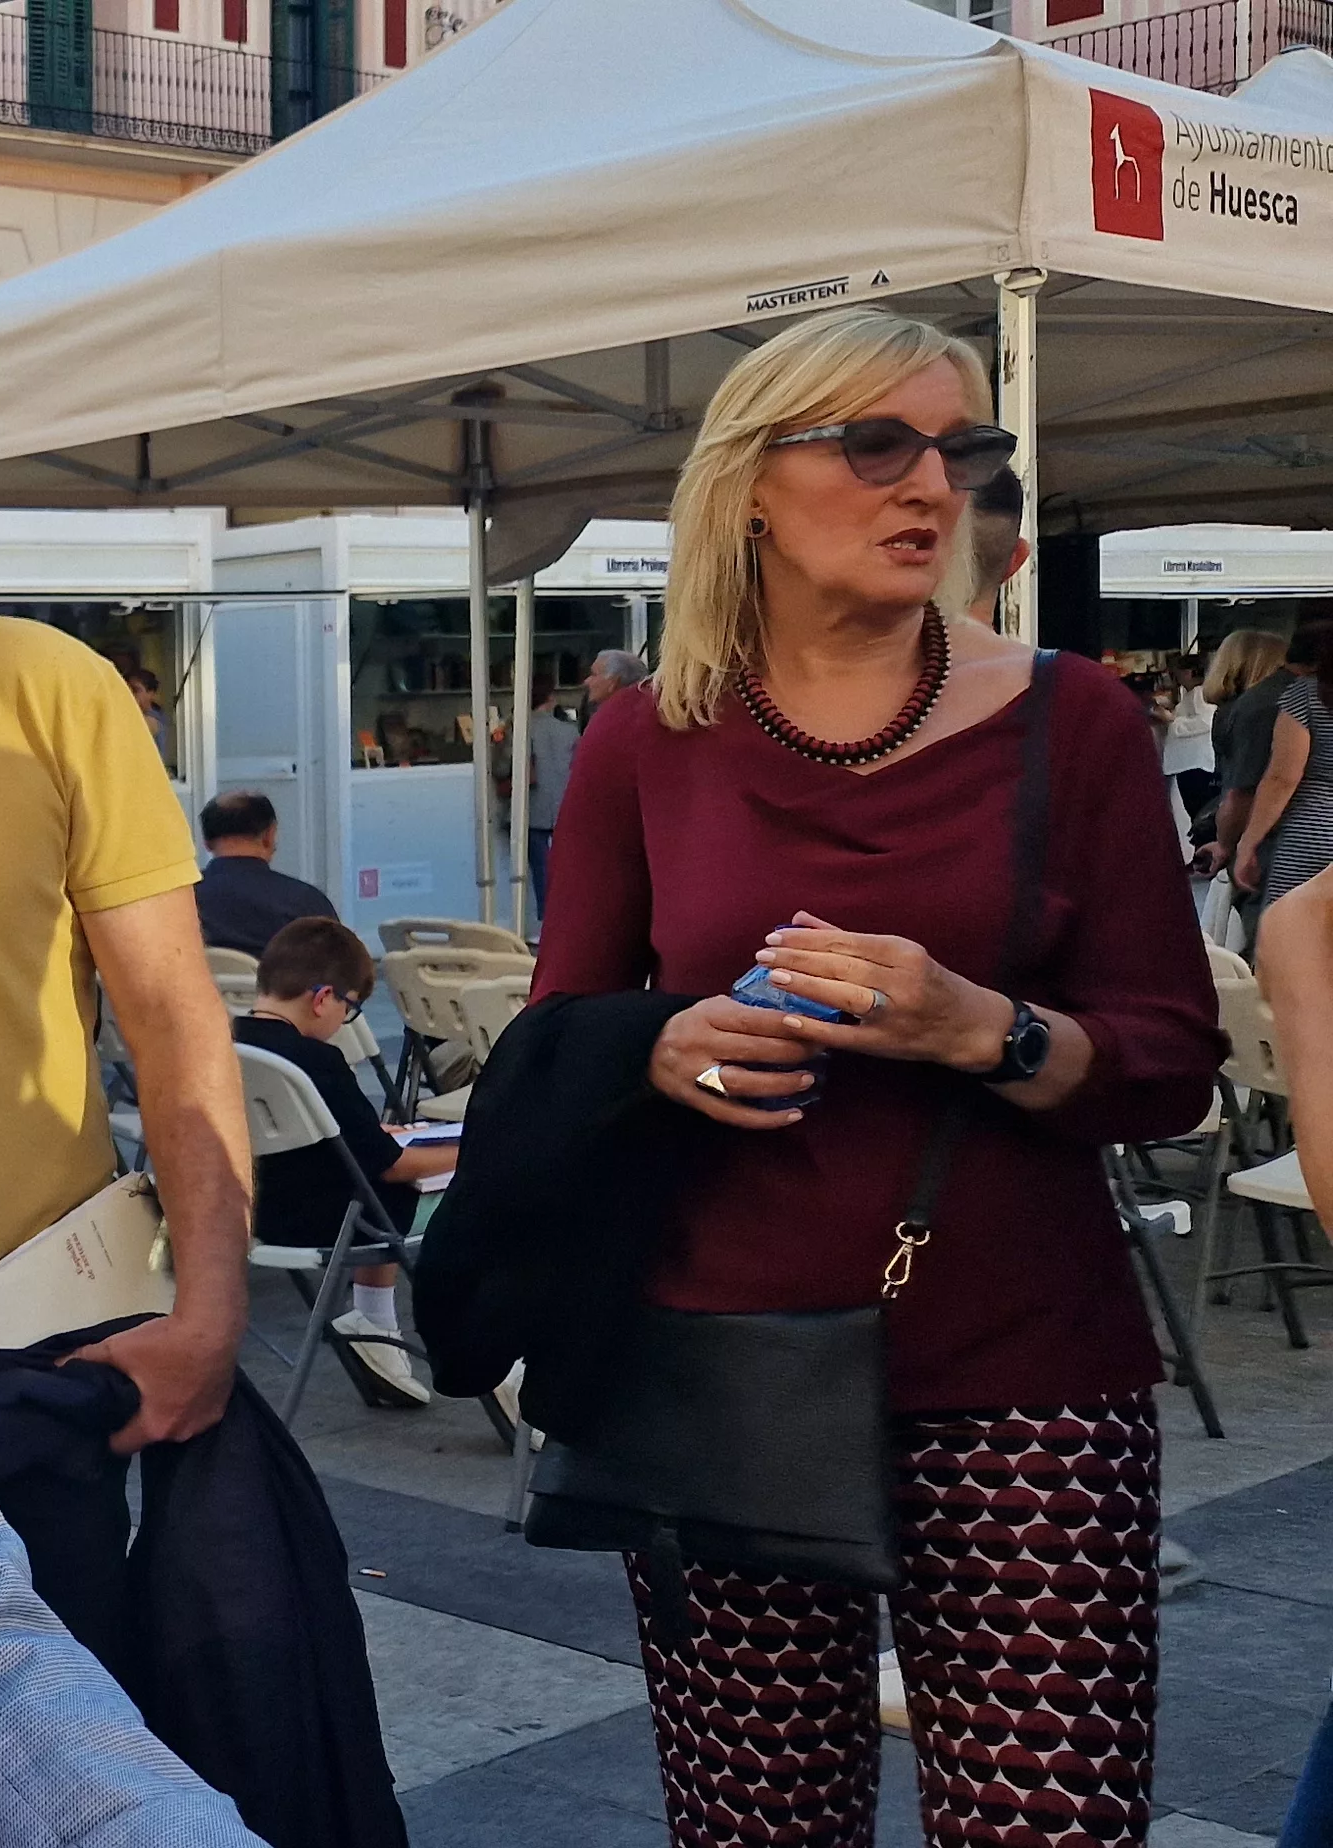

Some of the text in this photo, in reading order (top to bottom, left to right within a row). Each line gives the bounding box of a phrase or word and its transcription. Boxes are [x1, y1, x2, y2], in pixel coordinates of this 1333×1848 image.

[1172, 166, 1298, 226] de Huesca
[746, 281, 850, 313] MASTERTENT
